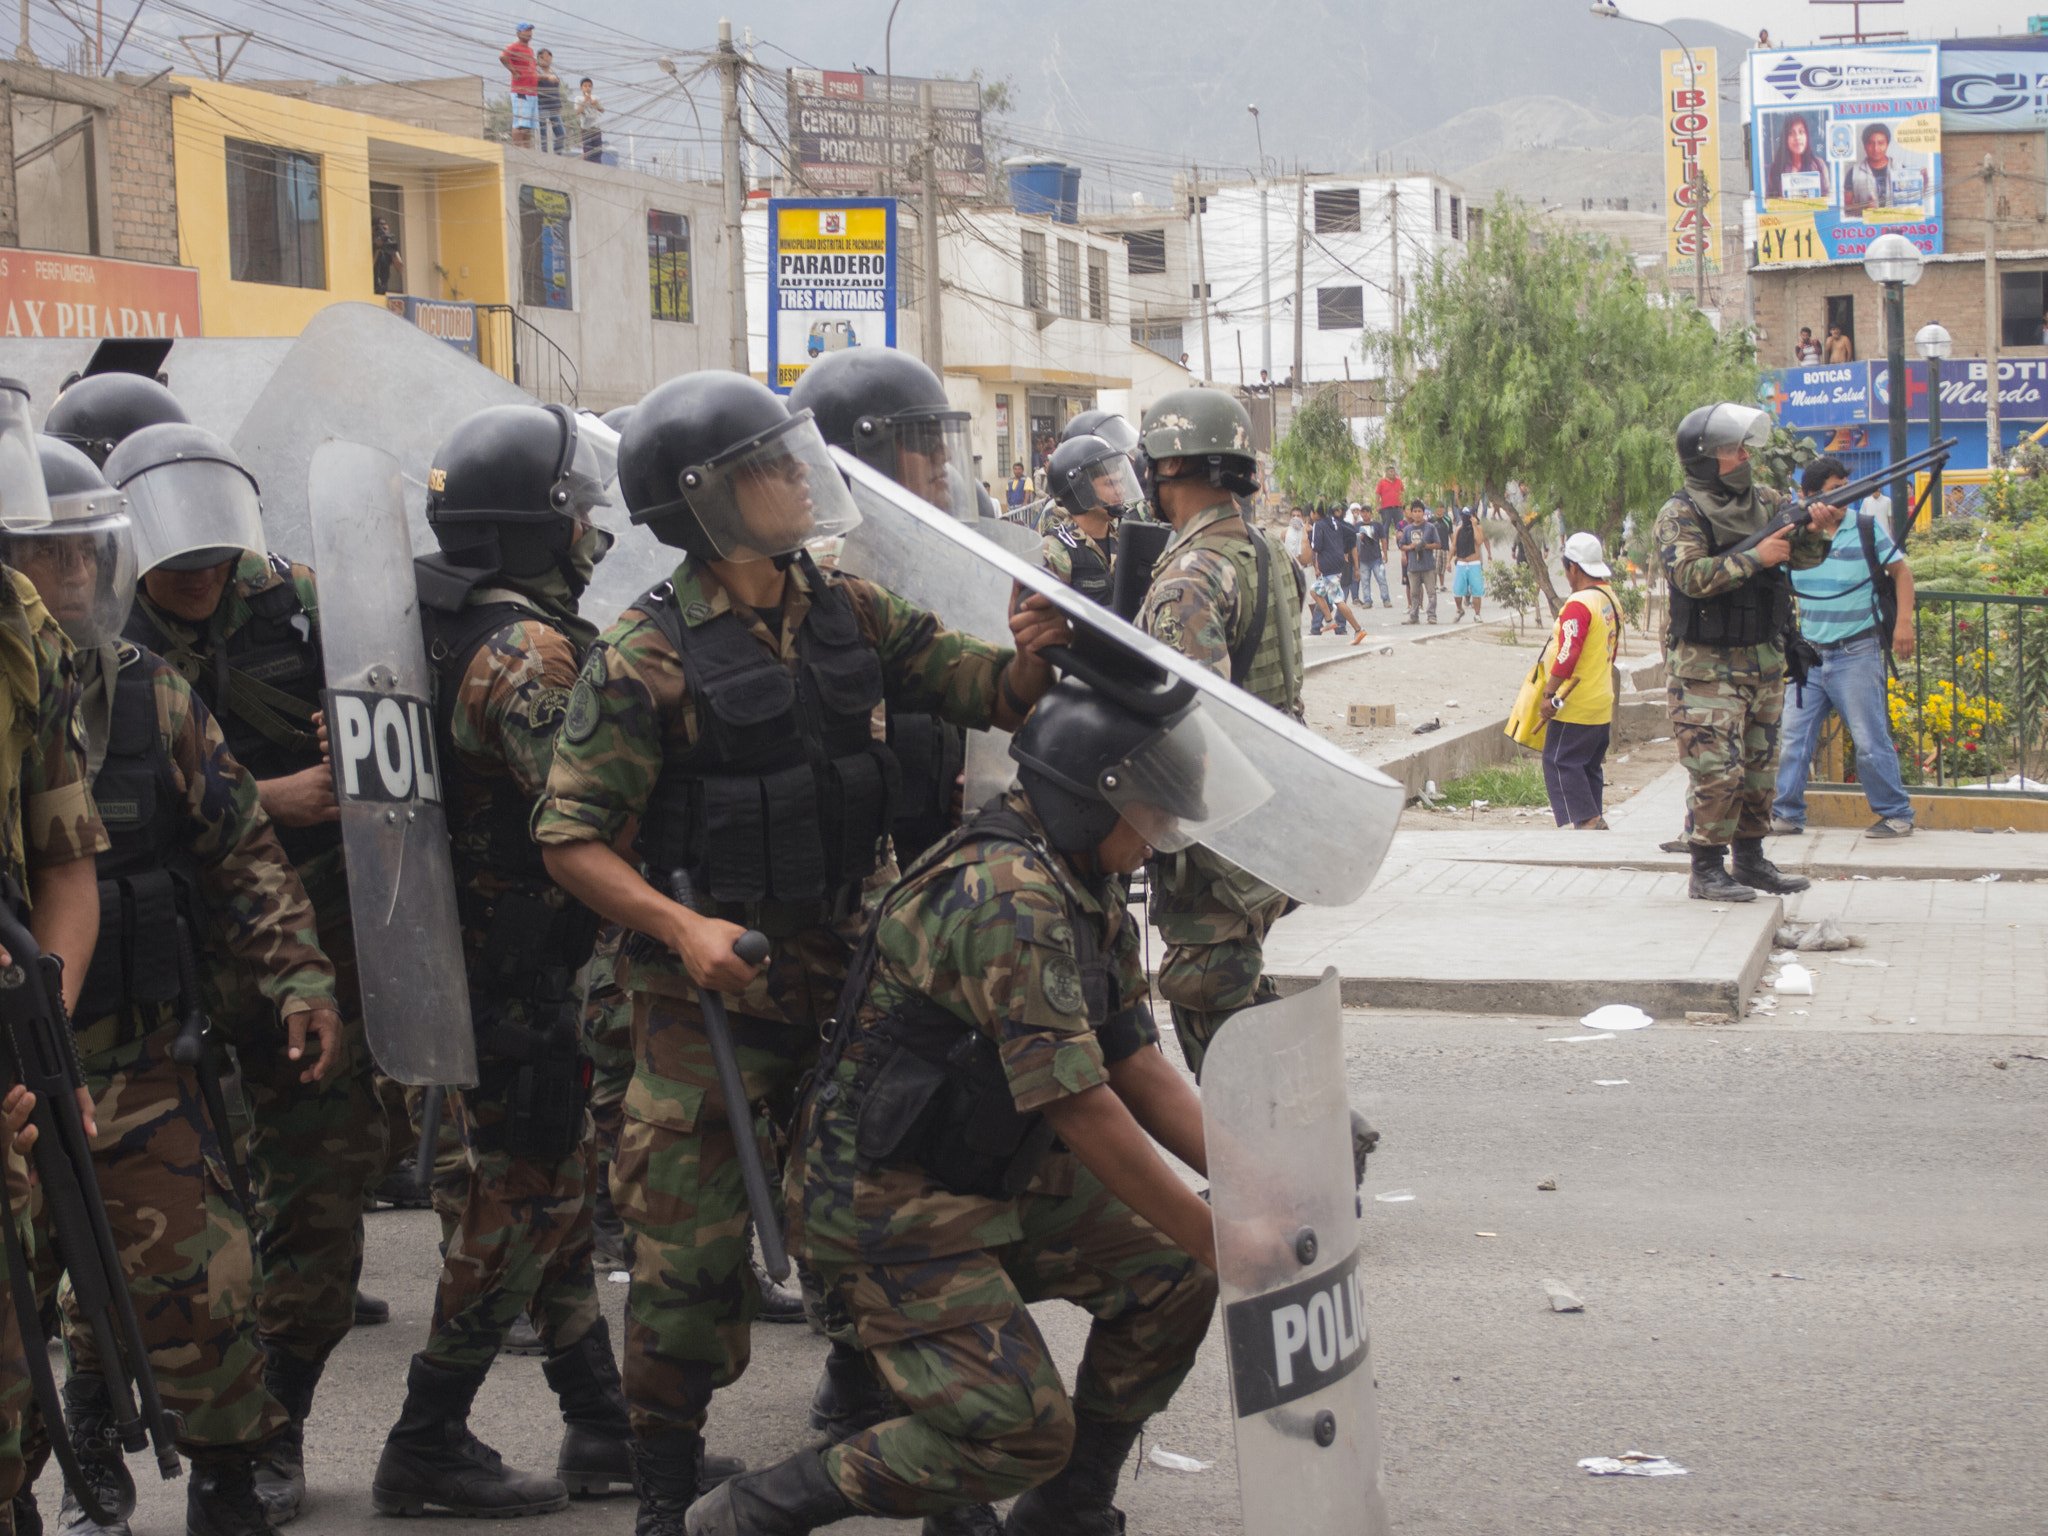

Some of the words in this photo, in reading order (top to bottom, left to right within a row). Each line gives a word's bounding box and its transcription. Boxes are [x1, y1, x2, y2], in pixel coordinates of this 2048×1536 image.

[801, 110, 855, 135] CENTRO
[820, 138, 880, 164] PORTADA
[1673, 88, 1713, 255] BOTICAS
[1763, 229, 1772, 258] 4
[1775, 228, 1787, 258] Y
[1794, 228, 1812, 258] 11
[1832, 227, 1876, 239] CICLO
[779, 239, 816, 250] MUNICIPALIDAD
[817, 239, 844, 251] DISTRITAL
[845, 239, 852, 250] DE
[1837, 244, 1866, 256] SAN
[35, 260, 95, 283] PERFUMERIA
[780, 255, 885, 275] PARADERO
[780, 278, 884, 287] AUTORIZADO
[779, 290, 813, 310] TRES
[816, 290, 884, 310] PORTADAS
[55, 302, 186, 338] PHARMA
[414, 302, 474, 341] LOCUTORIO
[1803, 368, 1852, 385] BOTICAS
[1790, 390, 1829, 407] Mundo
[1832, 386, 1866, 404] Salud
[335, 695, 442, 803] POLI
